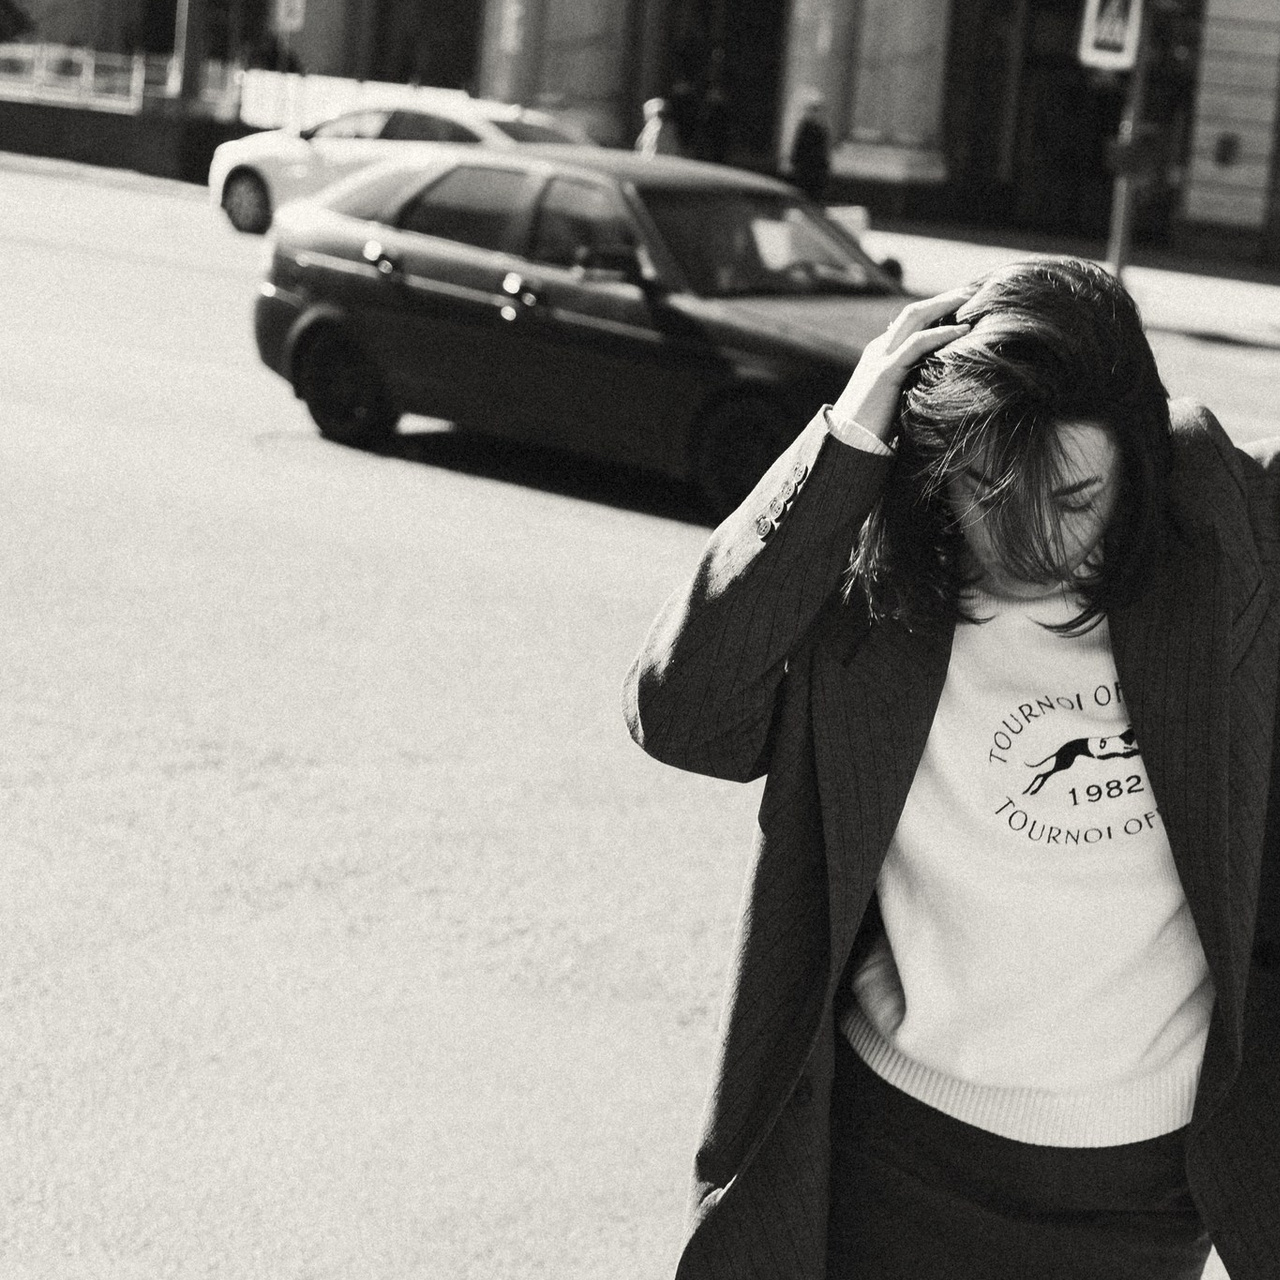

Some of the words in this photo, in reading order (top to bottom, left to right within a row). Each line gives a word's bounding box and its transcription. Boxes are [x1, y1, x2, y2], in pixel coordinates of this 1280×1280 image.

[988, 693, 1083, 763] TOURNOI
[1068, 774, 1145, 806] 1982
[995, 797, 1113, 844] TOURNOI
